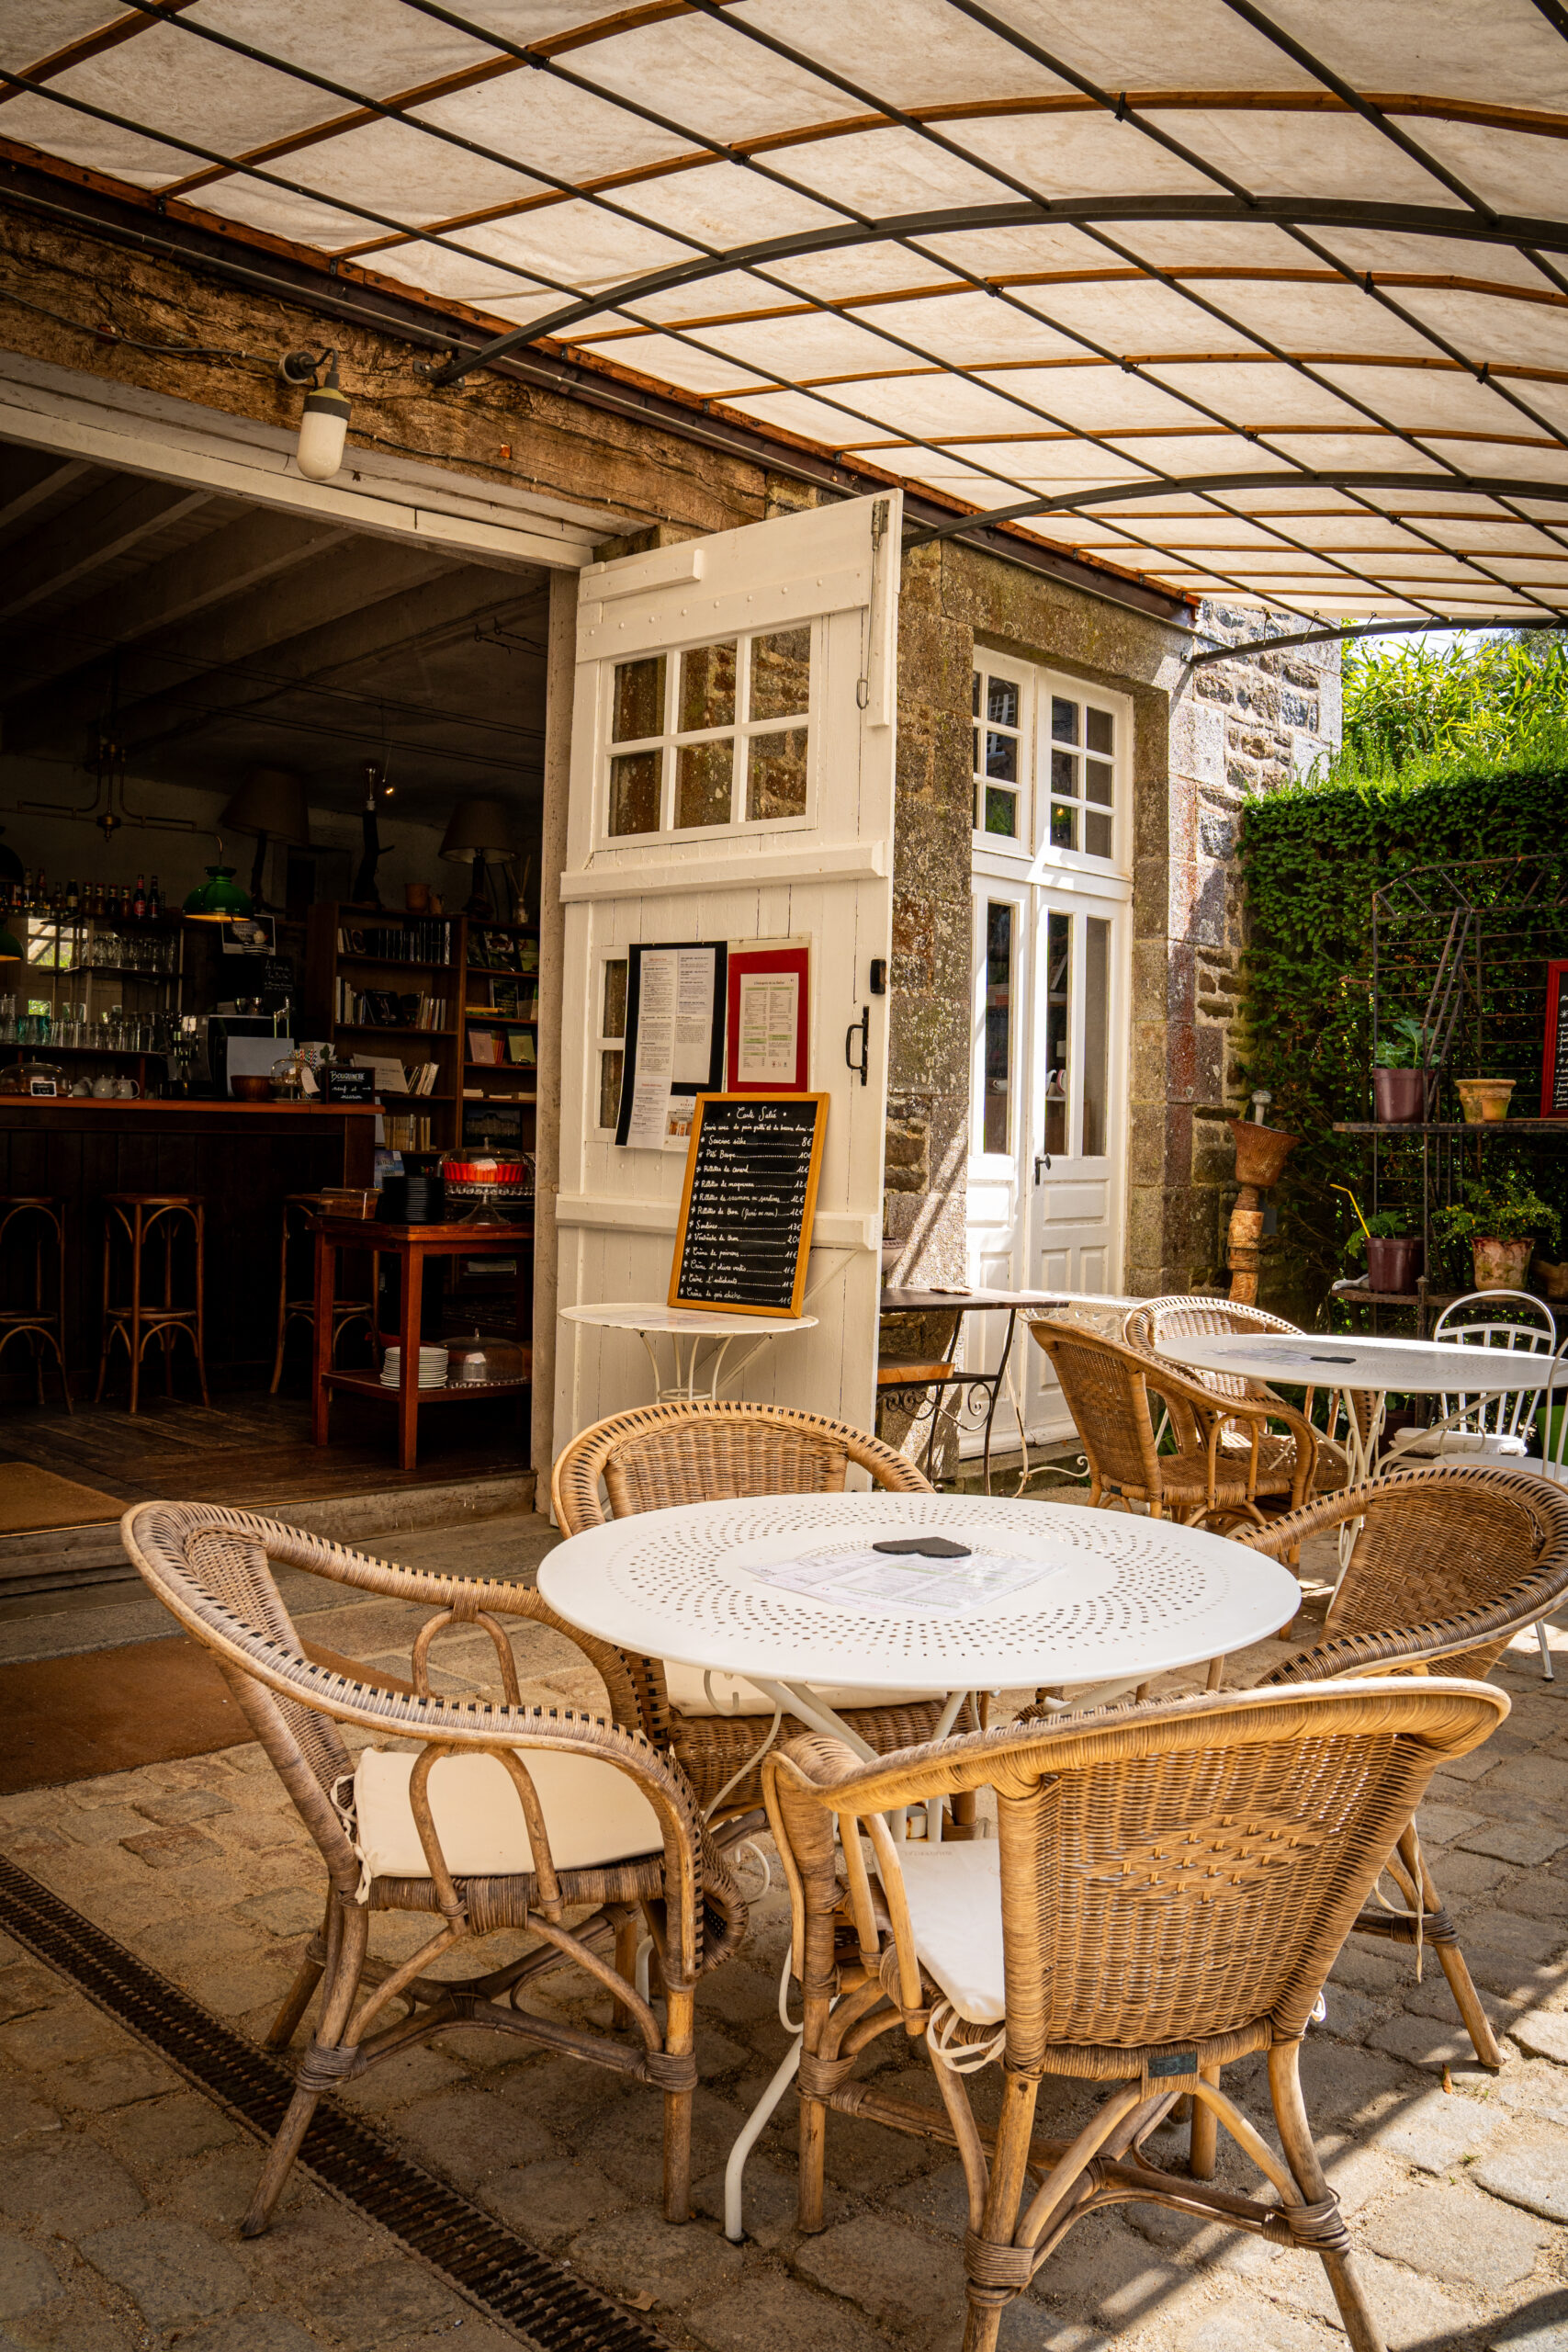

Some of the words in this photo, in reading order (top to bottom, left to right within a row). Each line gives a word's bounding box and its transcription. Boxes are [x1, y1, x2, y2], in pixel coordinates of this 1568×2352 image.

[737, 1107, 755, 1119] Carte
[741, 1124, 751, 1132] pain
[802, 1137, 812, 1147] 8€
[796, 1165, 809, 1173] 12€
[791, 1195, 805, 1204] 12€
[728, 1207, 739, 1216] thon
[790, 1208, 804, 1216] 12€
[696, 1220, 718, 1229] Sardines
[788, 1223, 802, 1231] 13€
[784, 1267, 795, 1275] 11€
